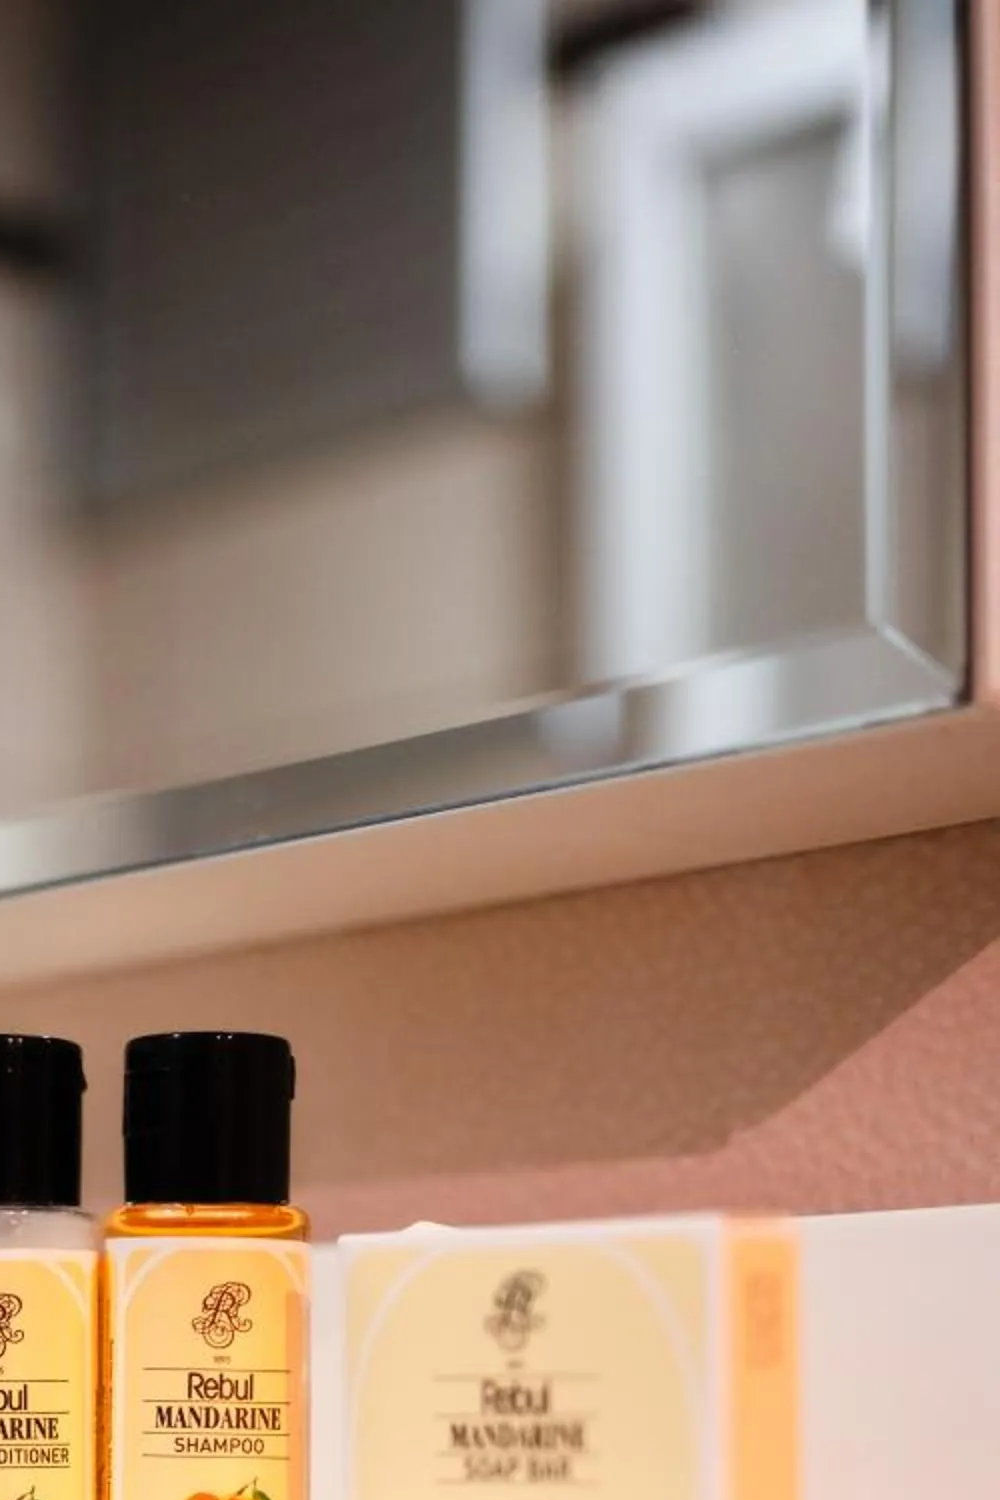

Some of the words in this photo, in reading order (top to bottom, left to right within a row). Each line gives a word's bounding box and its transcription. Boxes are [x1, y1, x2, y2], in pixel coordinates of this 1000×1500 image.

[187, 1371, 255, 1401] Rebul
[155, 1405, 282, 1431] MANDARINE
[173, 1436, 266, 1455] SHAMPOO
